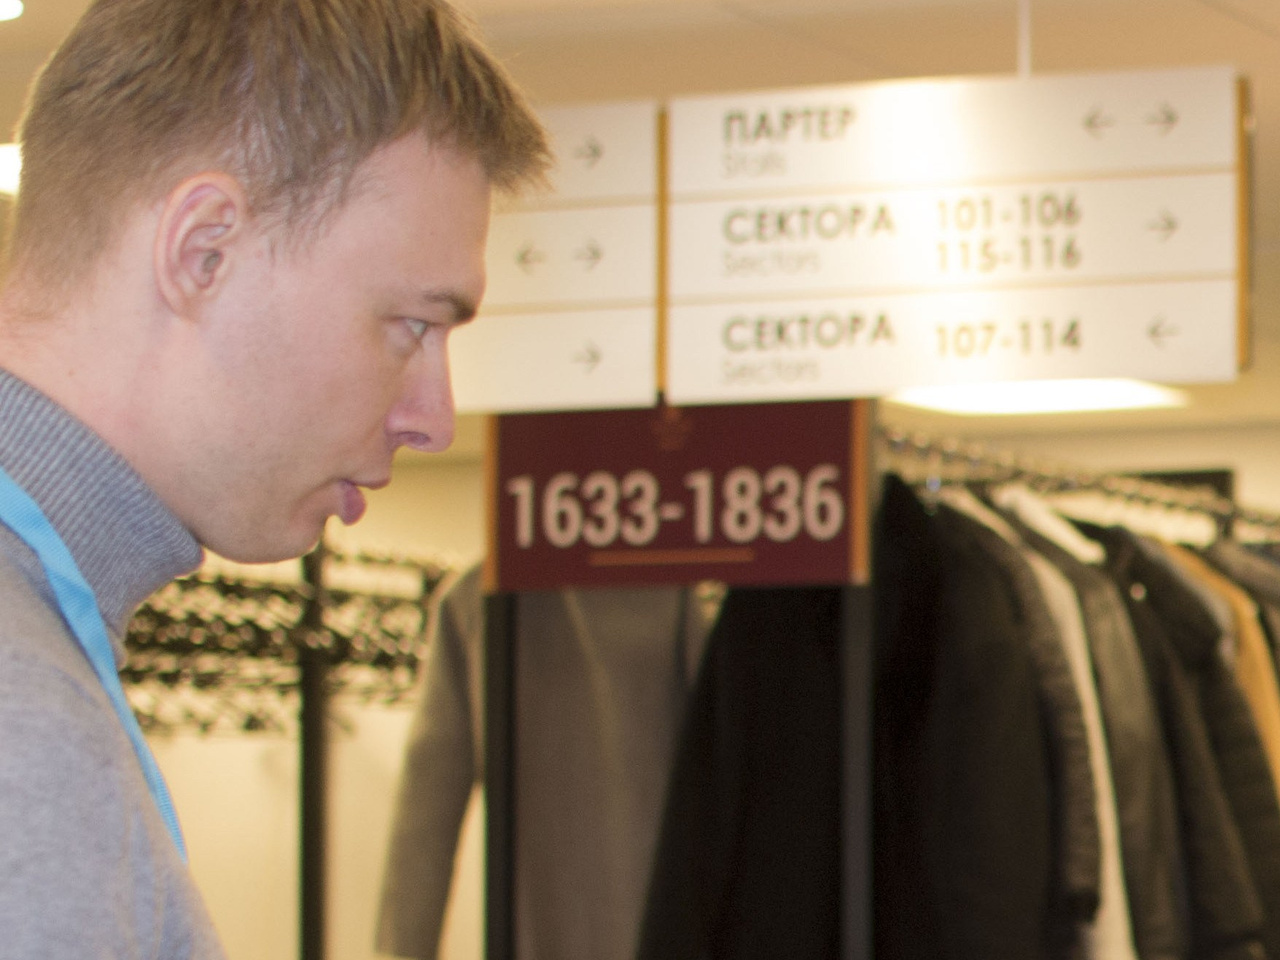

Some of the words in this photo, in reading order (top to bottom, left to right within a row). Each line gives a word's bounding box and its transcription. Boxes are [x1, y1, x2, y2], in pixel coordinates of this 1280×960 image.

[724, 107, 856, 143] ПАРТЕР
[723, 205, 894, 244] СЕКТОРА
[938, 194, 1081, 231] 101-106
[937, 235, 1081, 272] 115-116
[722, 313, 894, 351] СЕКТОРА
[936, 319, 1081, 357] 107-114
[507, 464, 845, 549] 1633-1836
